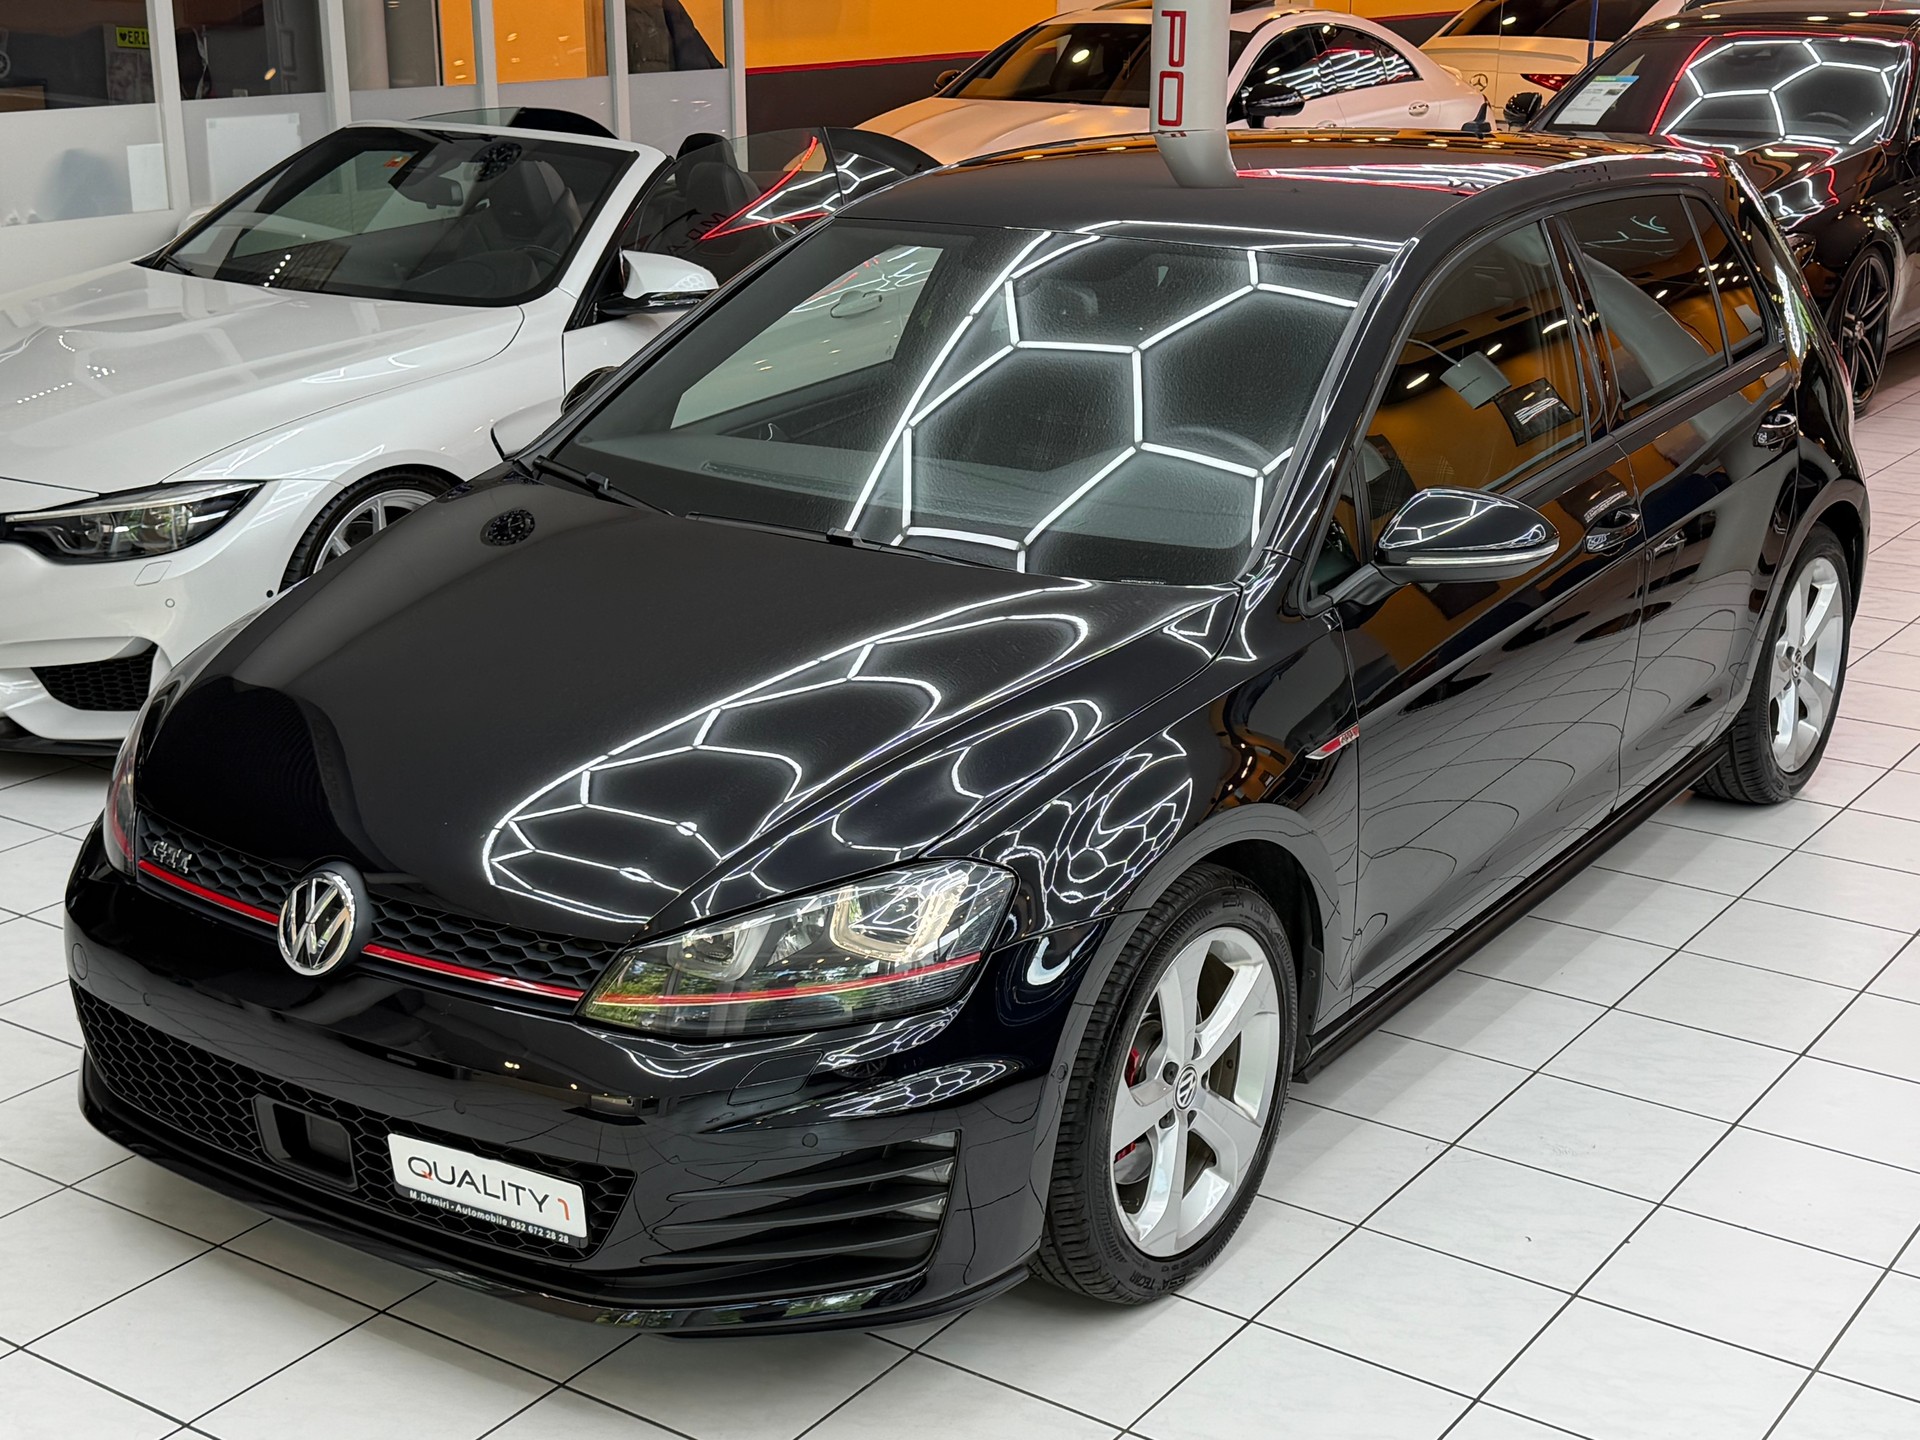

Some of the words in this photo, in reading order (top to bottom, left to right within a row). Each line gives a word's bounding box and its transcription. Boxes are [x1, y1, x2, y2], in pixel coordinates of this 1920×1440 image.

[127, 30, 149, 45] ERI
[408, 1156, 549, 1213] QUALITY
[455, 1204, 508, 1226] Automobile
[510, 1220, 526, 1231] 052
[528, 1225, 544, 1237] 672
[545, 1230, 557, 1240] 28
[558, 1233, 570, 1244] 28
